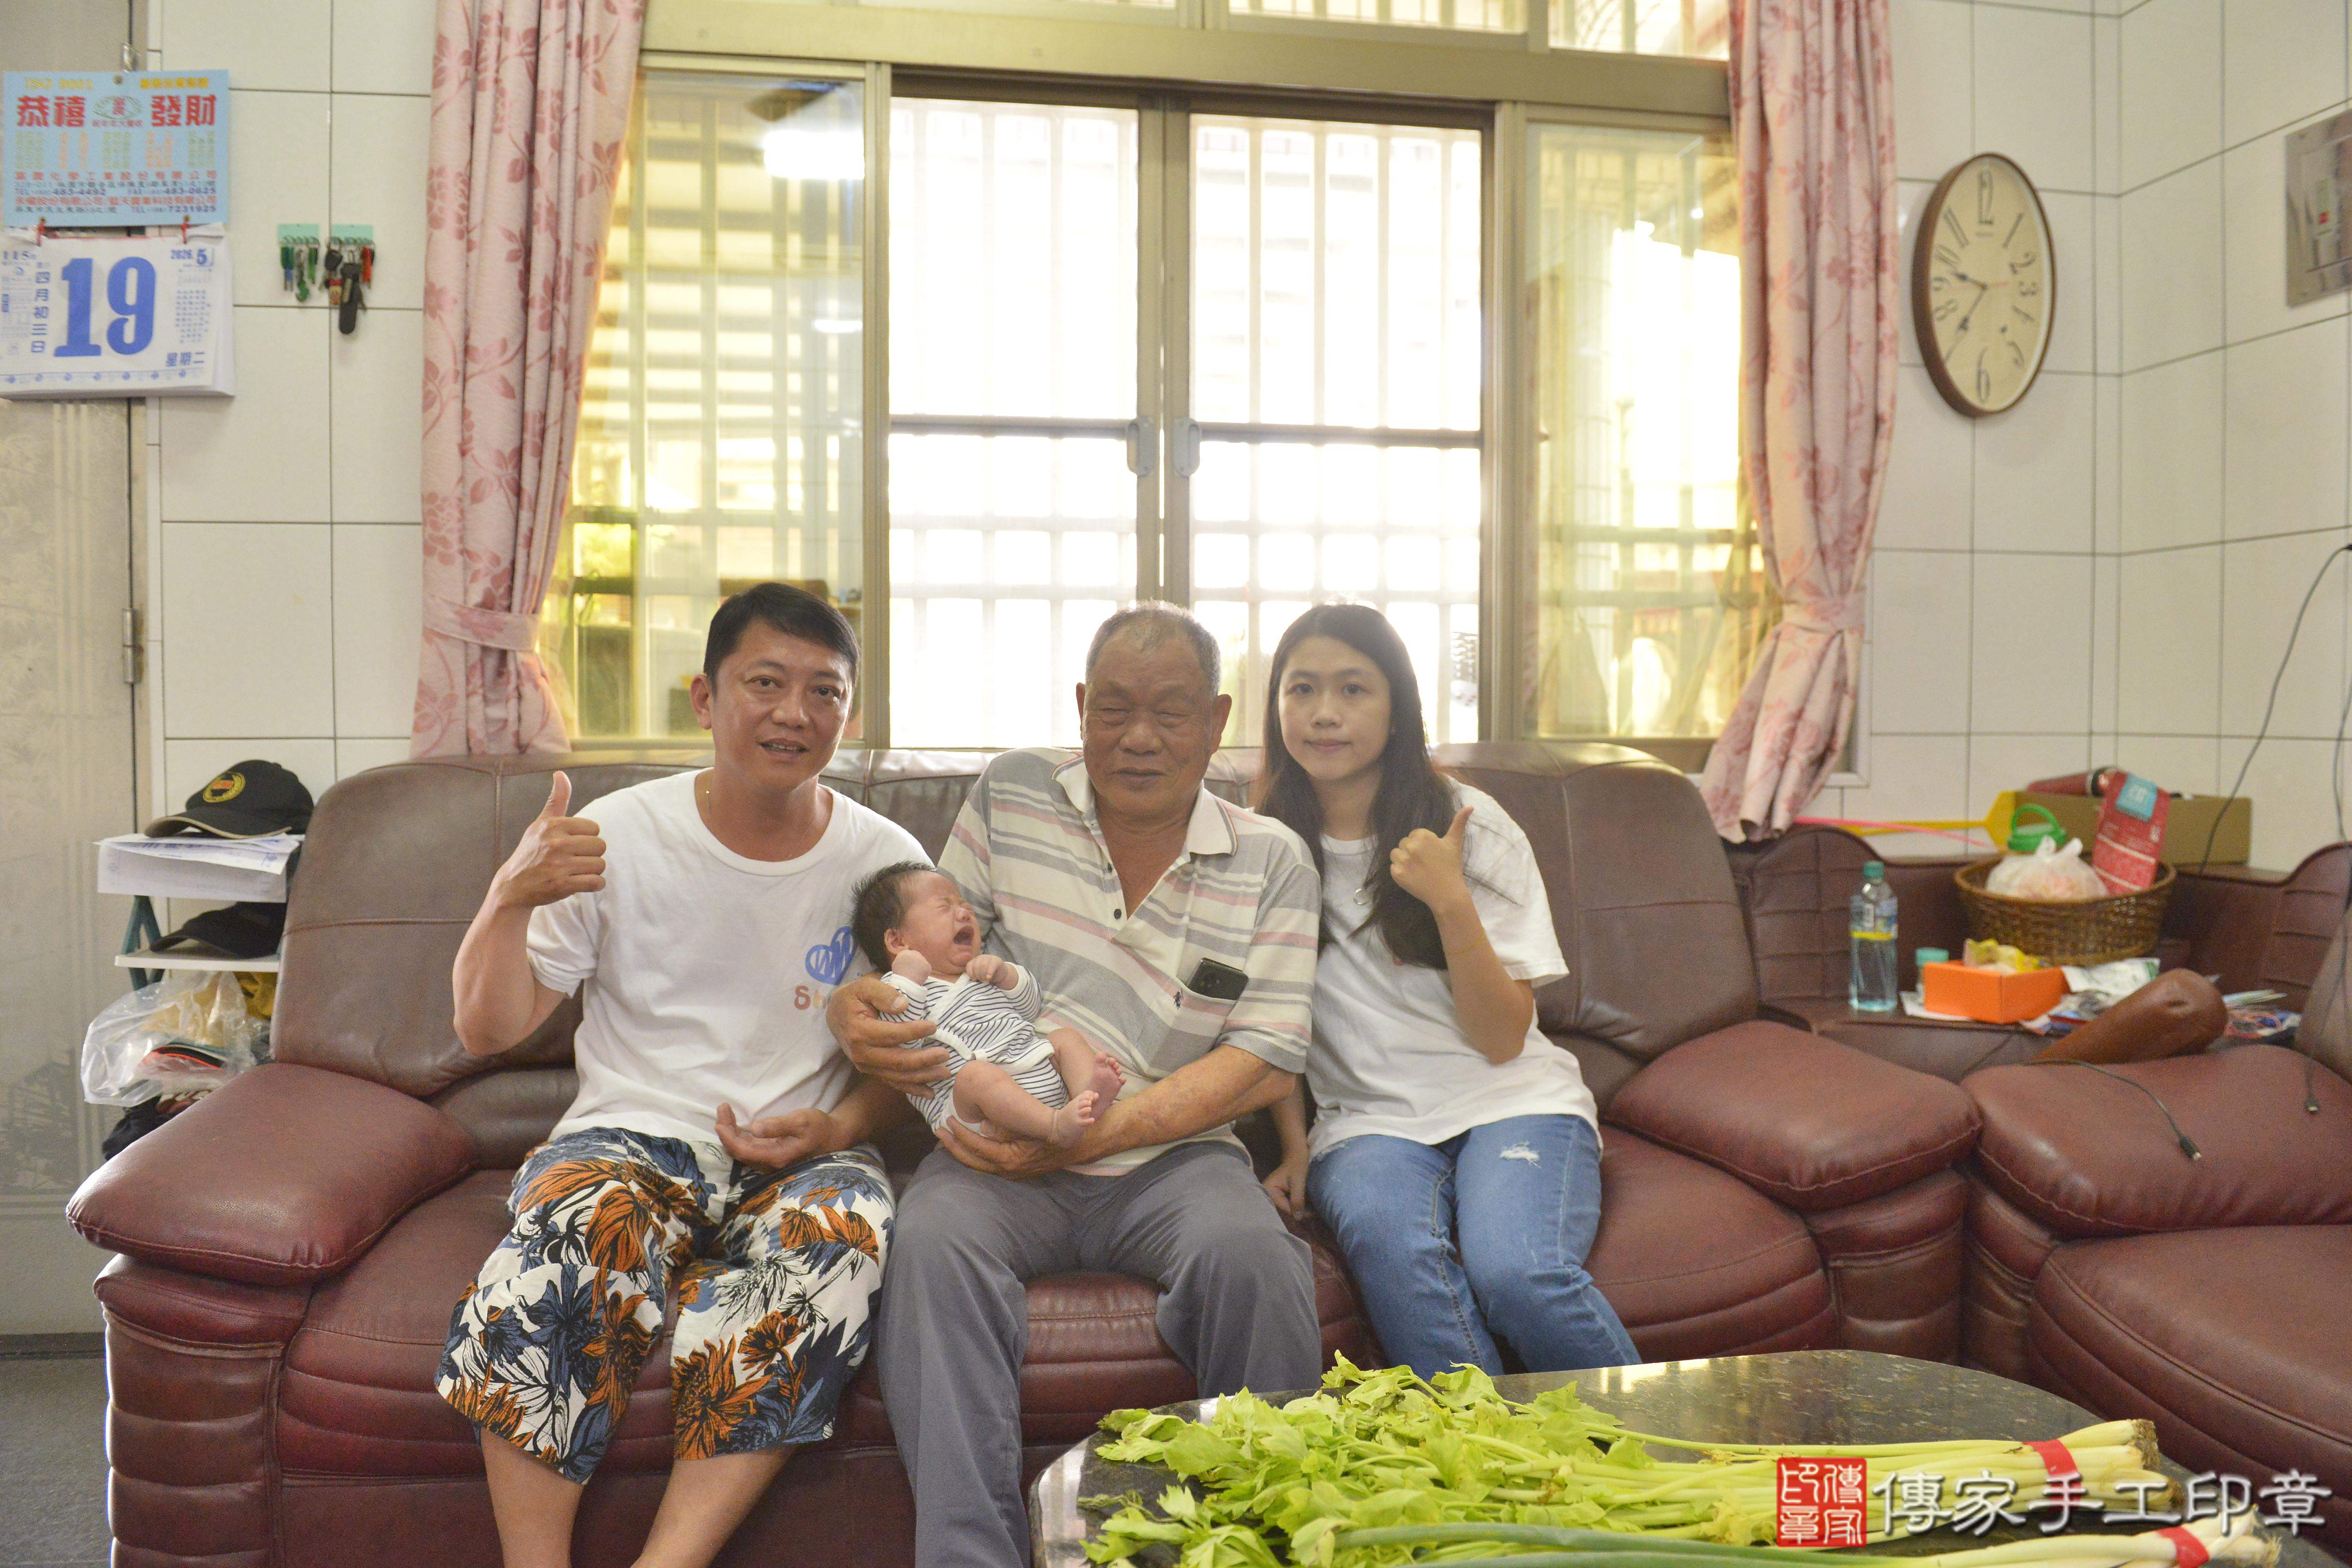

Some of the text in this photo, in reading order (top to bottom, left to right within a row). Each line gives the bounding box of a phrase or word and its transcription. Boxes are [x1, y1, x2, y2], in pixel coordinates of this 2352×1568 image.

[17, 95, 86, 127] 恭禧
[151, 94, 216, 127] 發財
[196, 248, 207, 265] 5
[54, 257, 156, 357] 19
[1976, 346, 1991, 404] 6
